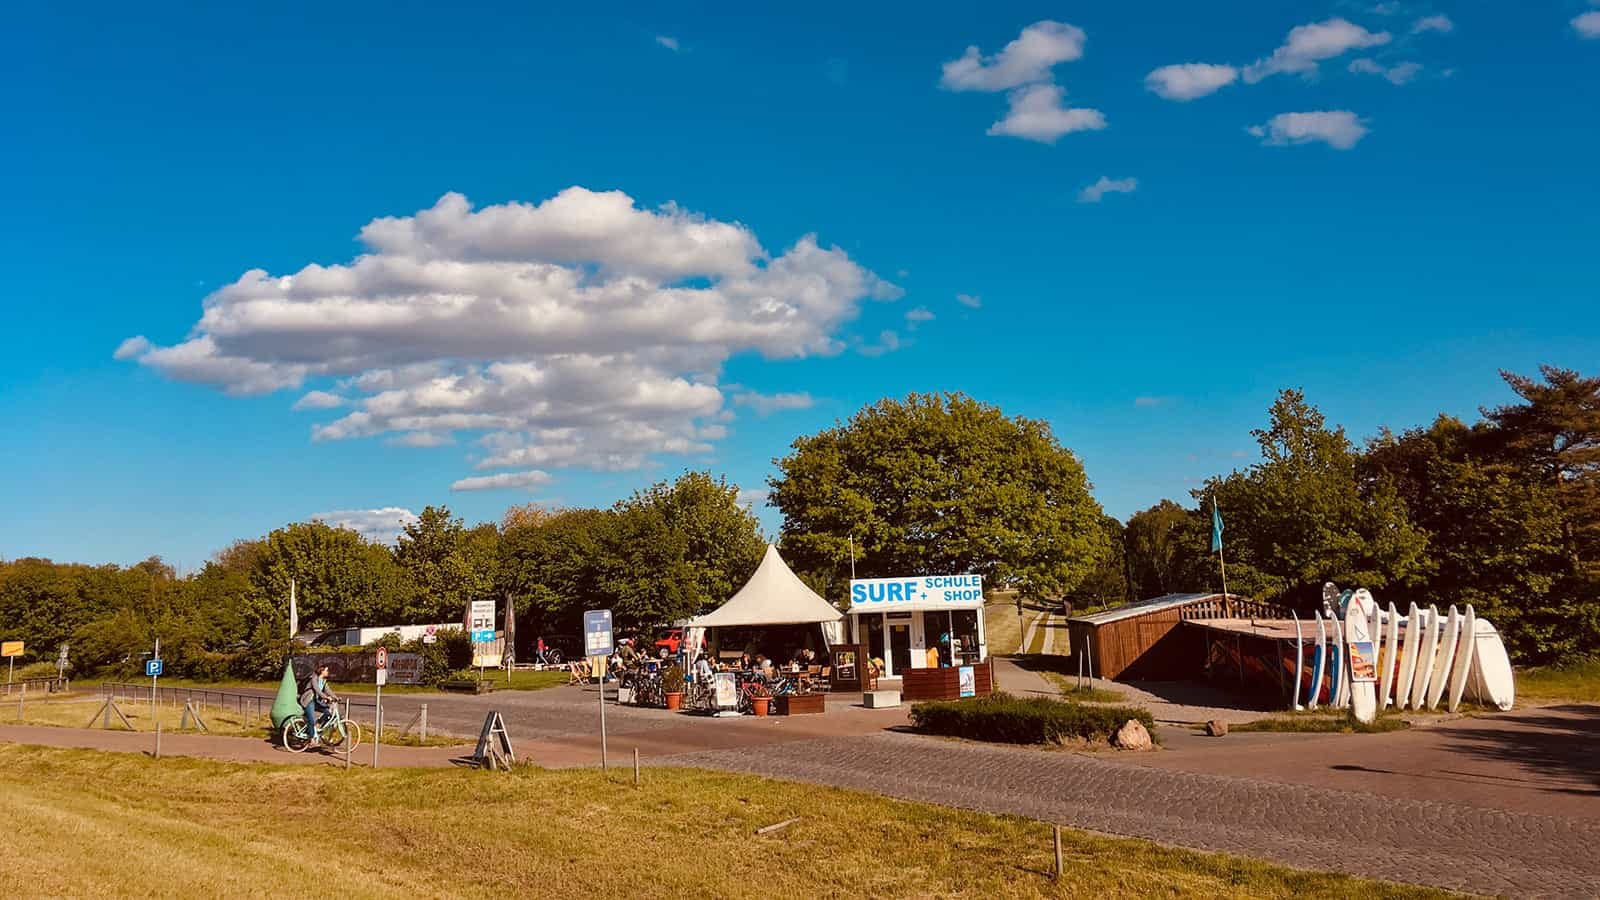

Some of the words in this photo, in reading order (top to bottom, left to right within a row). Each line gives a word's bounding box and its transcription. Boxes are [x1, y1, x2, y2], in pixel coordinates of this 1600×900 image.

[925, 576, 980, 588] SCHULE
[852, 582, 918, 603] SURF
[944, 589, 981, 601] SHOP
[150, 662, 159, 673] P
